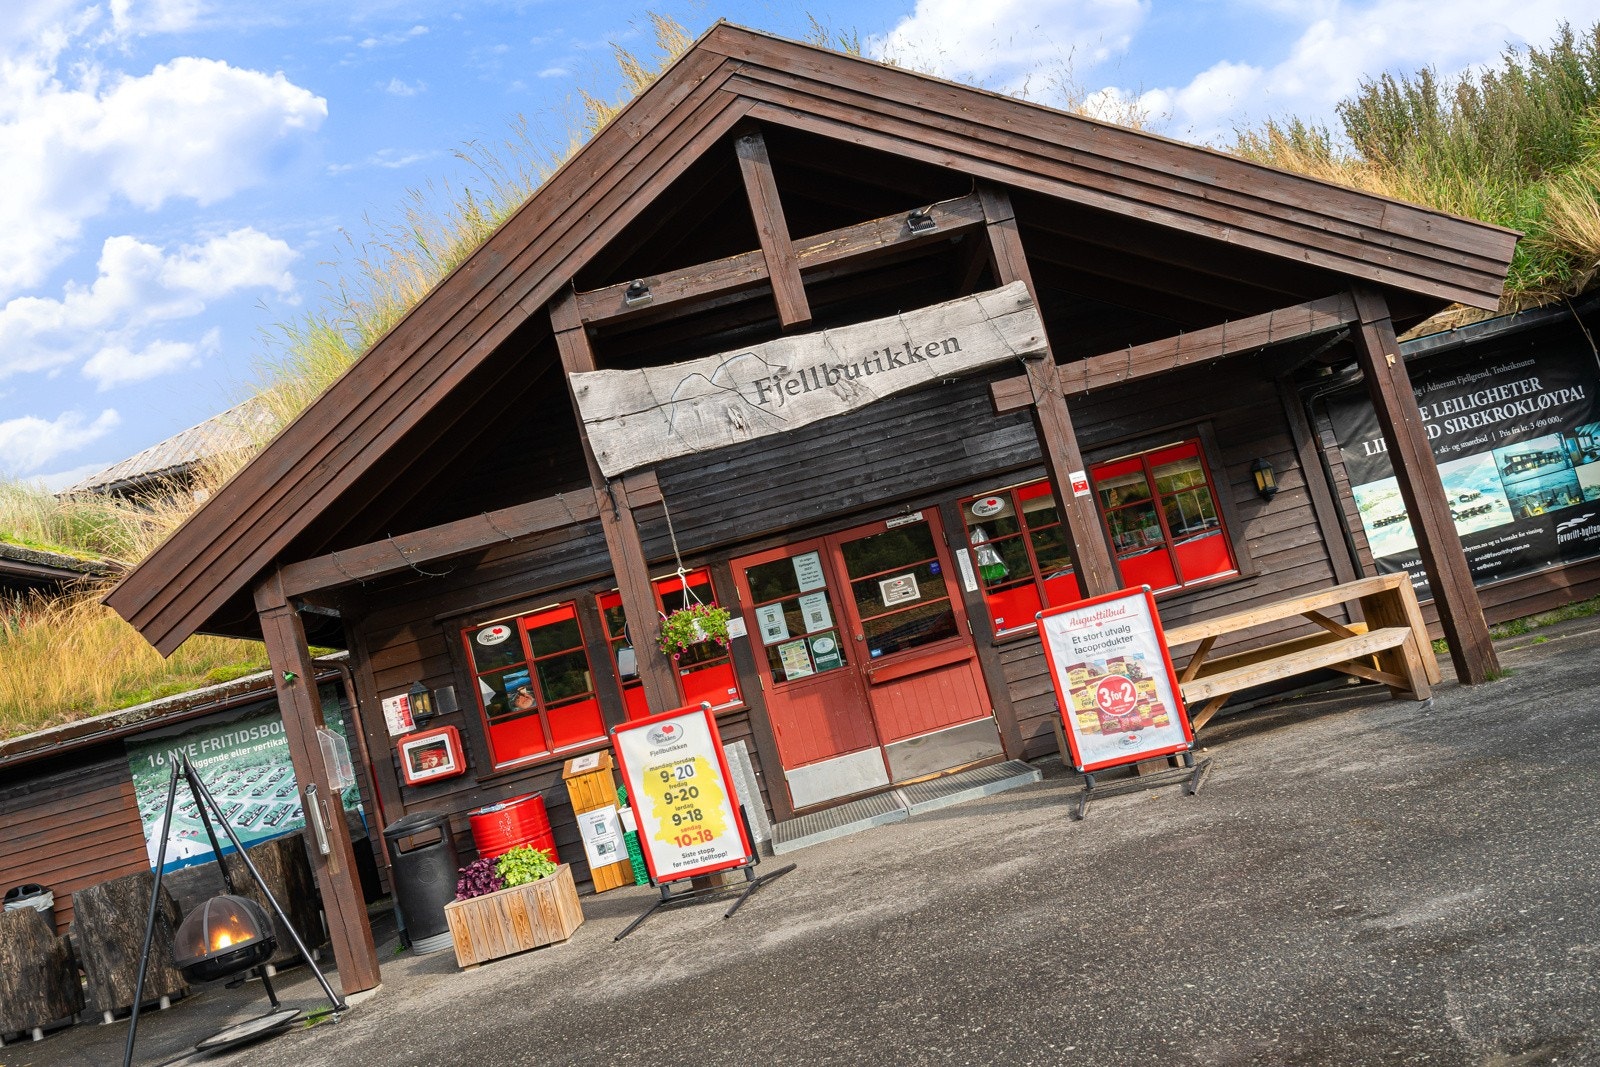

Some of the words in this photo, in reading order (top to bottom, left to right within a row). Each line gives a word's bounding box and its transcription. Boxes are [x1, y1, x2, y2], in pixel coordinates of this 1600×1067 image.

[752, 337, 963, 408] Fjellbutikken
[1427, 379, 1457, 392] Ådneram
[1457, 369, 1492, 385] Fjellgrend,
[1491, 358, 1536, 375] Troheiknuten
[1432, 377, 1543, 417] LEILIGHETER
[1445, 385, 1586, 435] SIREKROKLØYPA!
[1452, 444, 1461, 452] og
[1499, 429, 1512, 438] Pris
[1511, 426, 1521, 434] fra
[1520, 424, 1530, 432] kr.
[1530, 422, 1535, 430] 3
[1535, 418, 1547, 428] 490
[1069, 605, 1126, 628] Augusttilbud
[1071, 636, 1081, 645] Et
[1083, 631, 1103, 642] stort
[1105, 625, 1131, 637] utvalg
[1074, 635, 1134, 655] tacoprodukter
[1099, 687, 1112, 707] 3
[1111, 690, 1123, 701] for
[1121, 682, 1134, 703] 2
[147, 752, 165, 768] 16
[168, 743, 198, 763] NYE
[230, 747, 251, 758] eller
[649, 743, 688, 757] Fjellbutikken
[649, 757, 696, 772] mandag-torsdag
[660, 764, 694, 783] 9-20
[669, 781, 688, 790] fredag
[664, 786, 699, 805] 9-20
[675, 803, 694, 811] lørdag
[672, 808, 704, 826] 9-18
[680, 824, 702, 833] søndag
[674, 829, 714, 848] 10-18
[681, 850, 697, 859] Siste
[697, 847, 715, 856] stopp
[683, 858, 699, 866] neste
[700, 850, 728, 862] fjelltopp!
